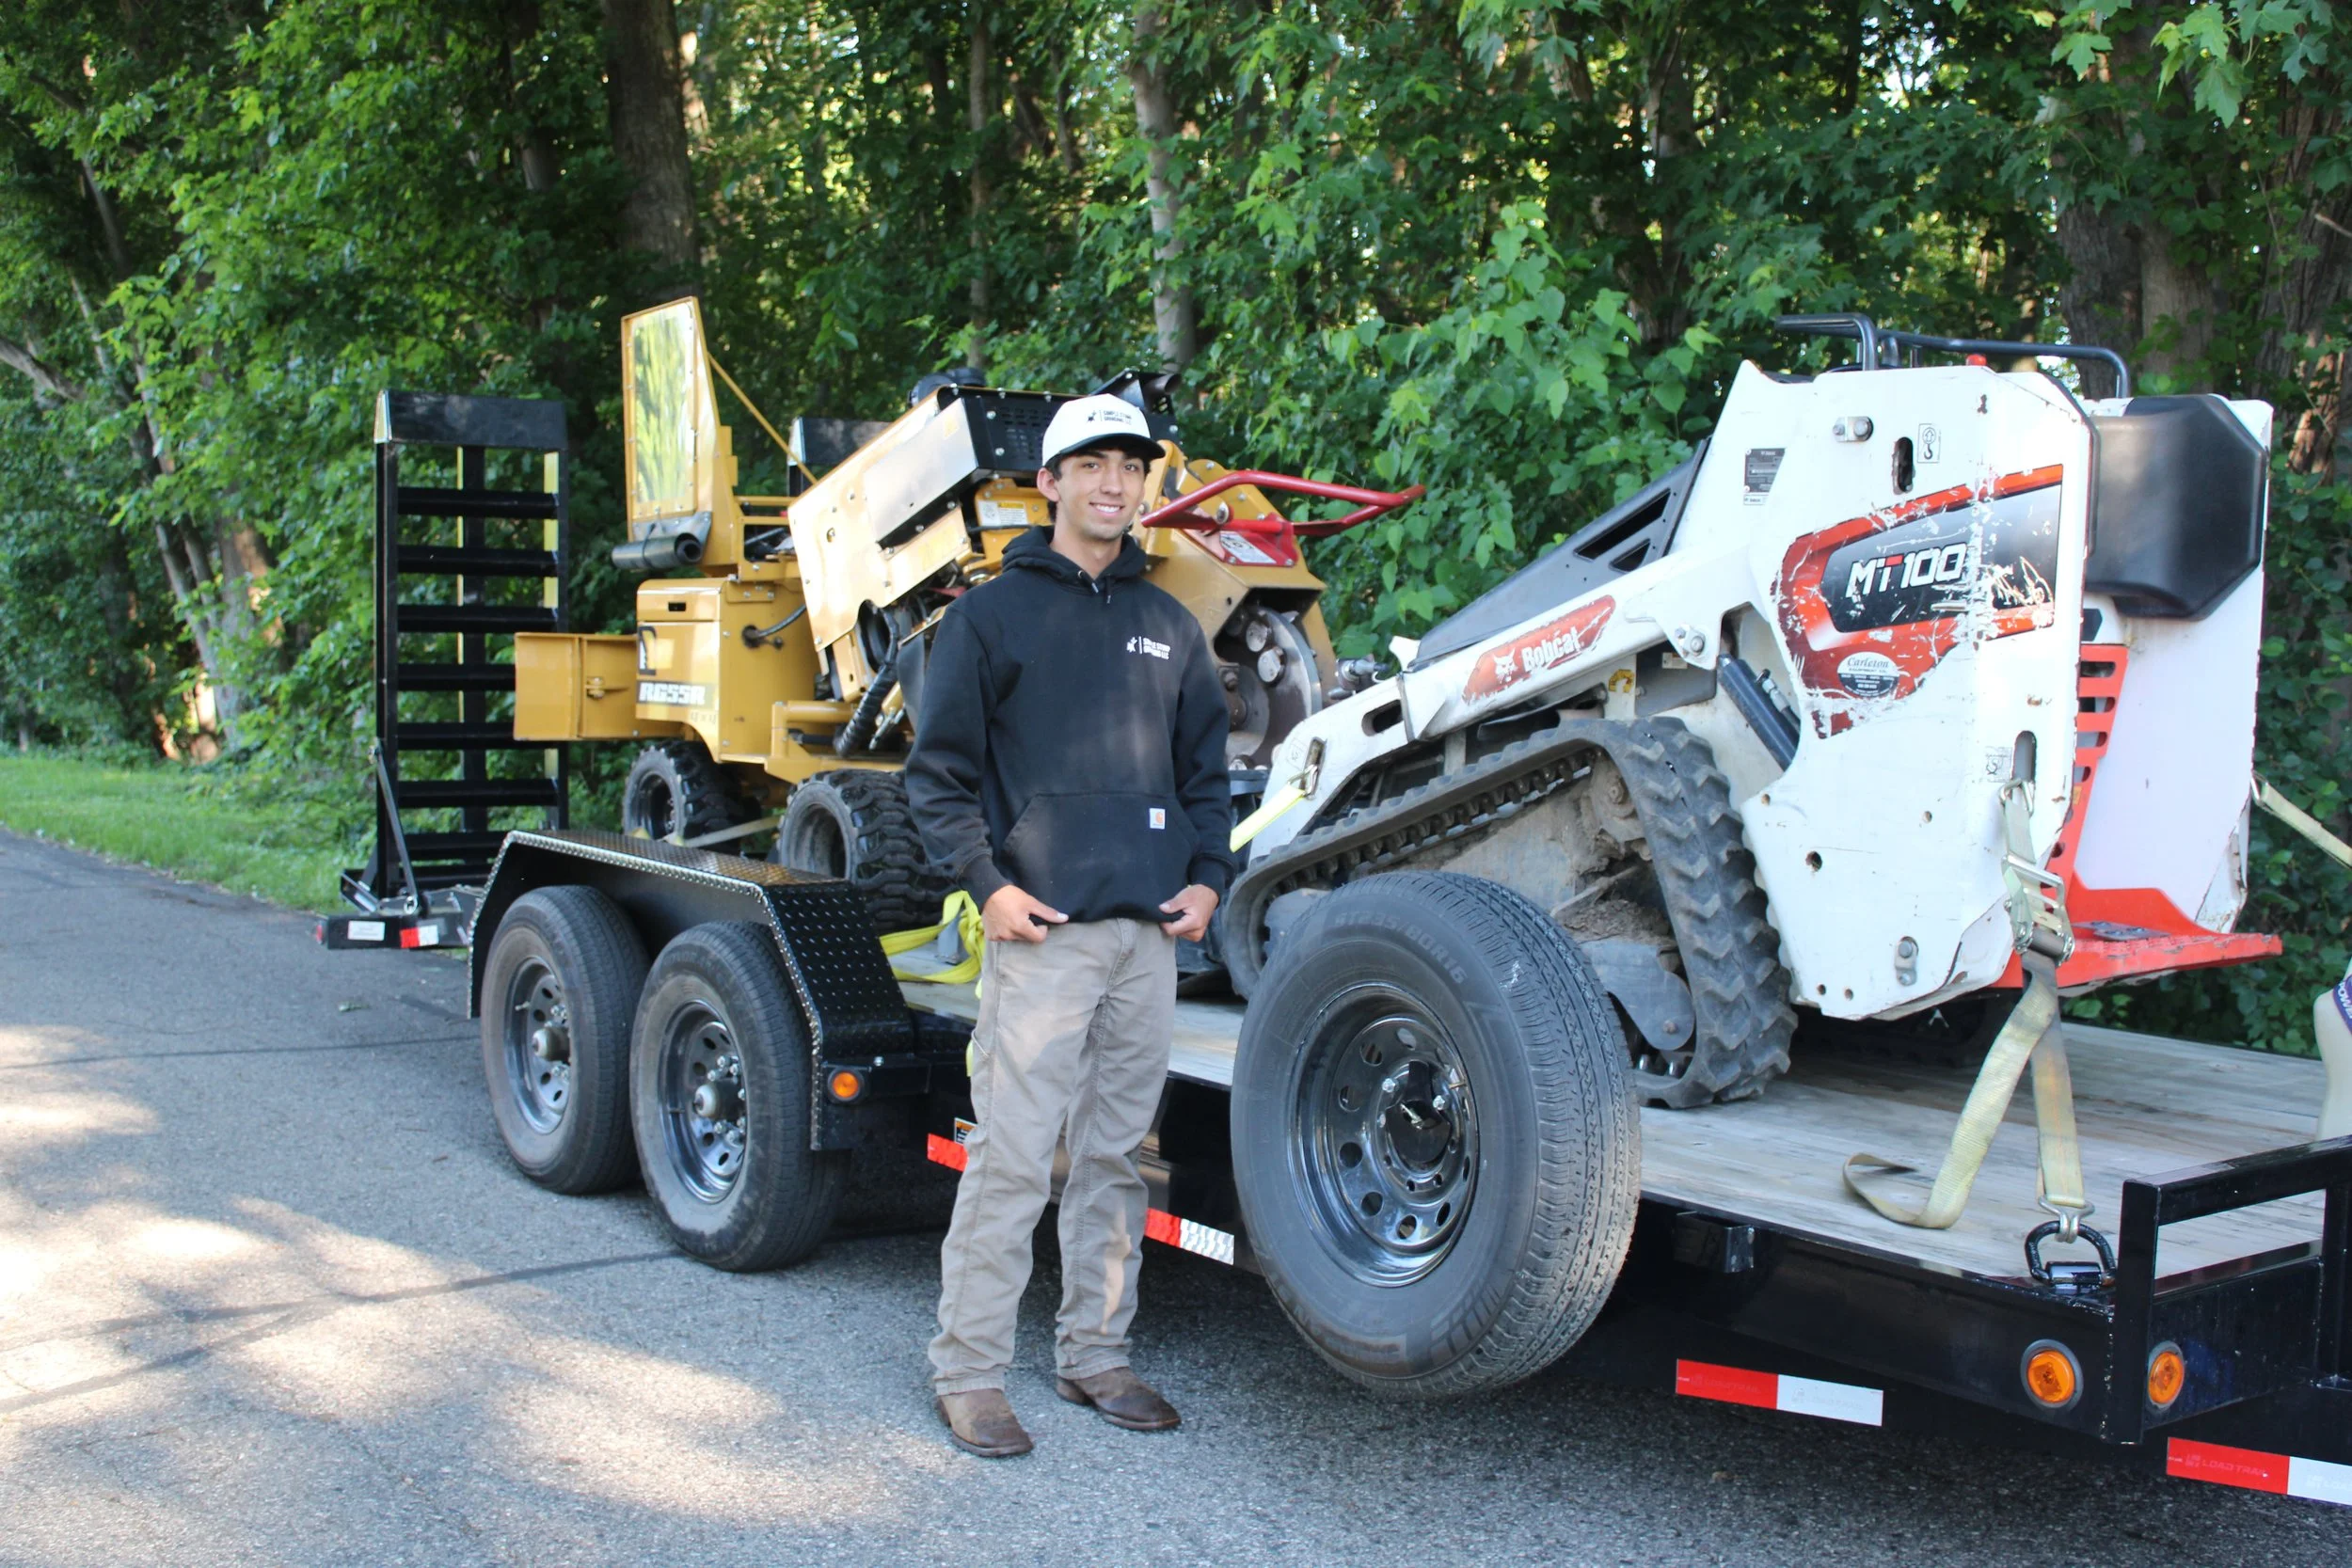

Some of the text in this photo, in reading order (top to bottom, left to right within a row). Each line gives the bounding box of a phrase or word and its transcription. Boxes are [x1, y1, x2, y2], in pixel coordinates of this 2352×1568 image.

[1845, 542, 1967, 598] MT100
[1521, 626, 1581, 672] Bobcat
[1847, 657, 1889, 668] Carleton
